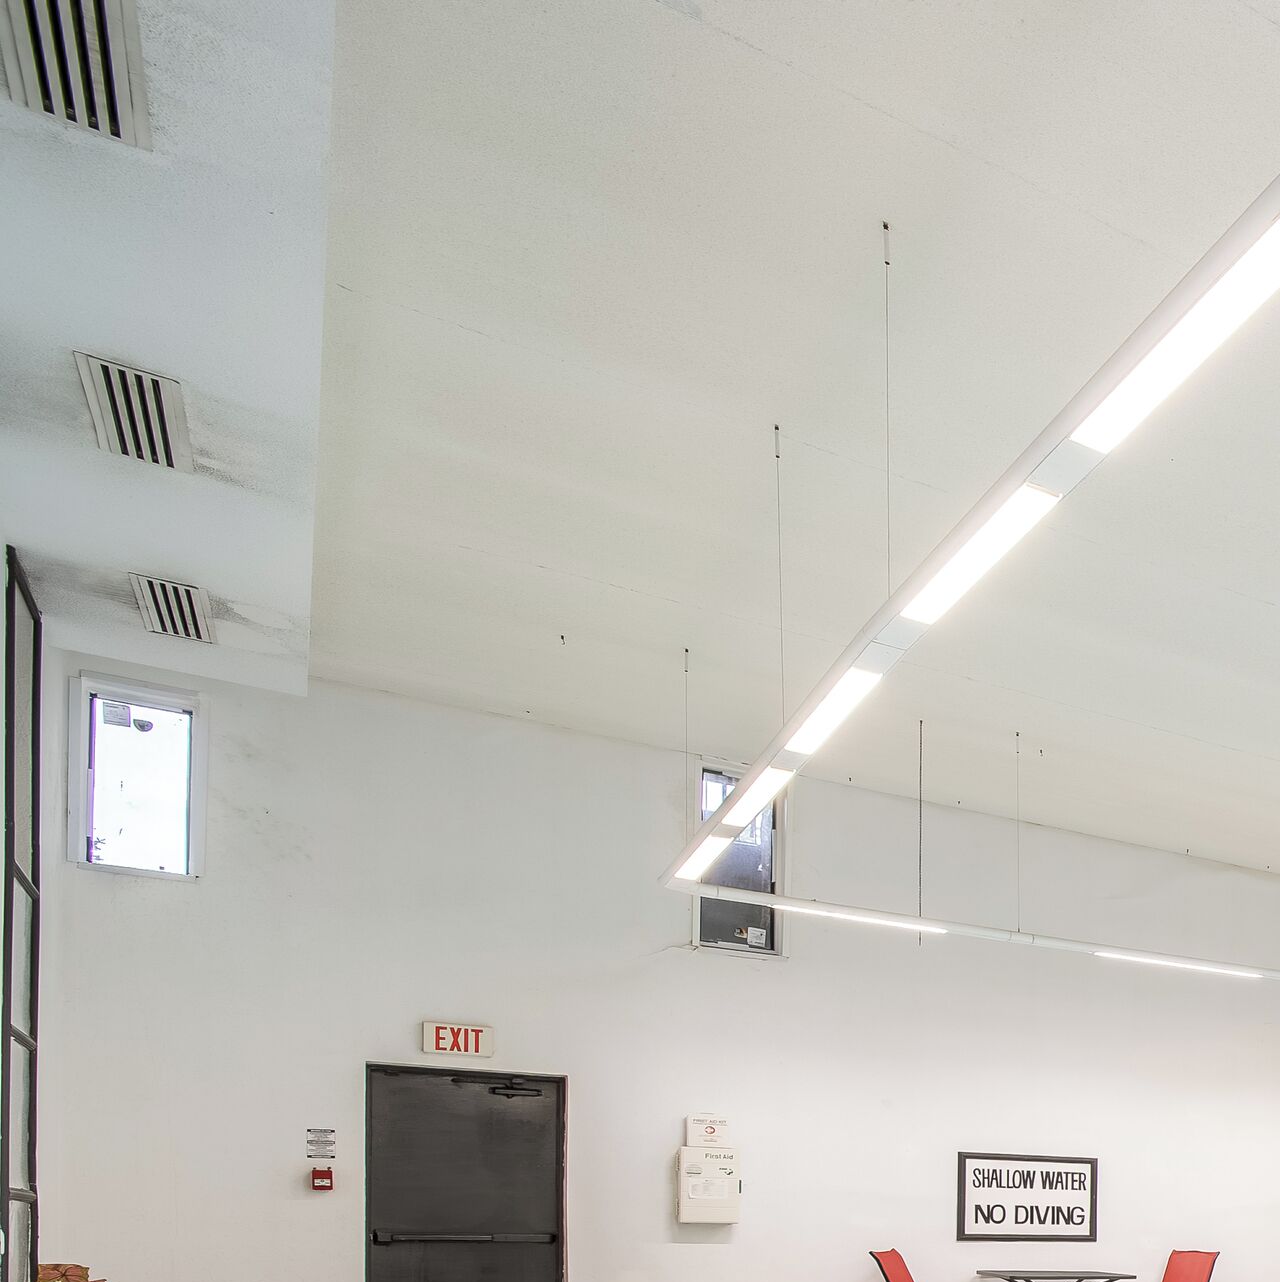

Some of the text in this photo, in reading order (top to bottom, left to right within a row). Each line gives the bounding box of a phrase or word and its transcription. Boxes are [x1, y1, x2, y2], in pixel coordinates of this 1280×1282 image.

[435, 1026, 484, 1053] EXIT
[704, 1152, 722, 1160] First
[972, 1167, 1087, 1191] SHALLOW WATER
[974, 1204, 1086, 1226] NO DIVING
